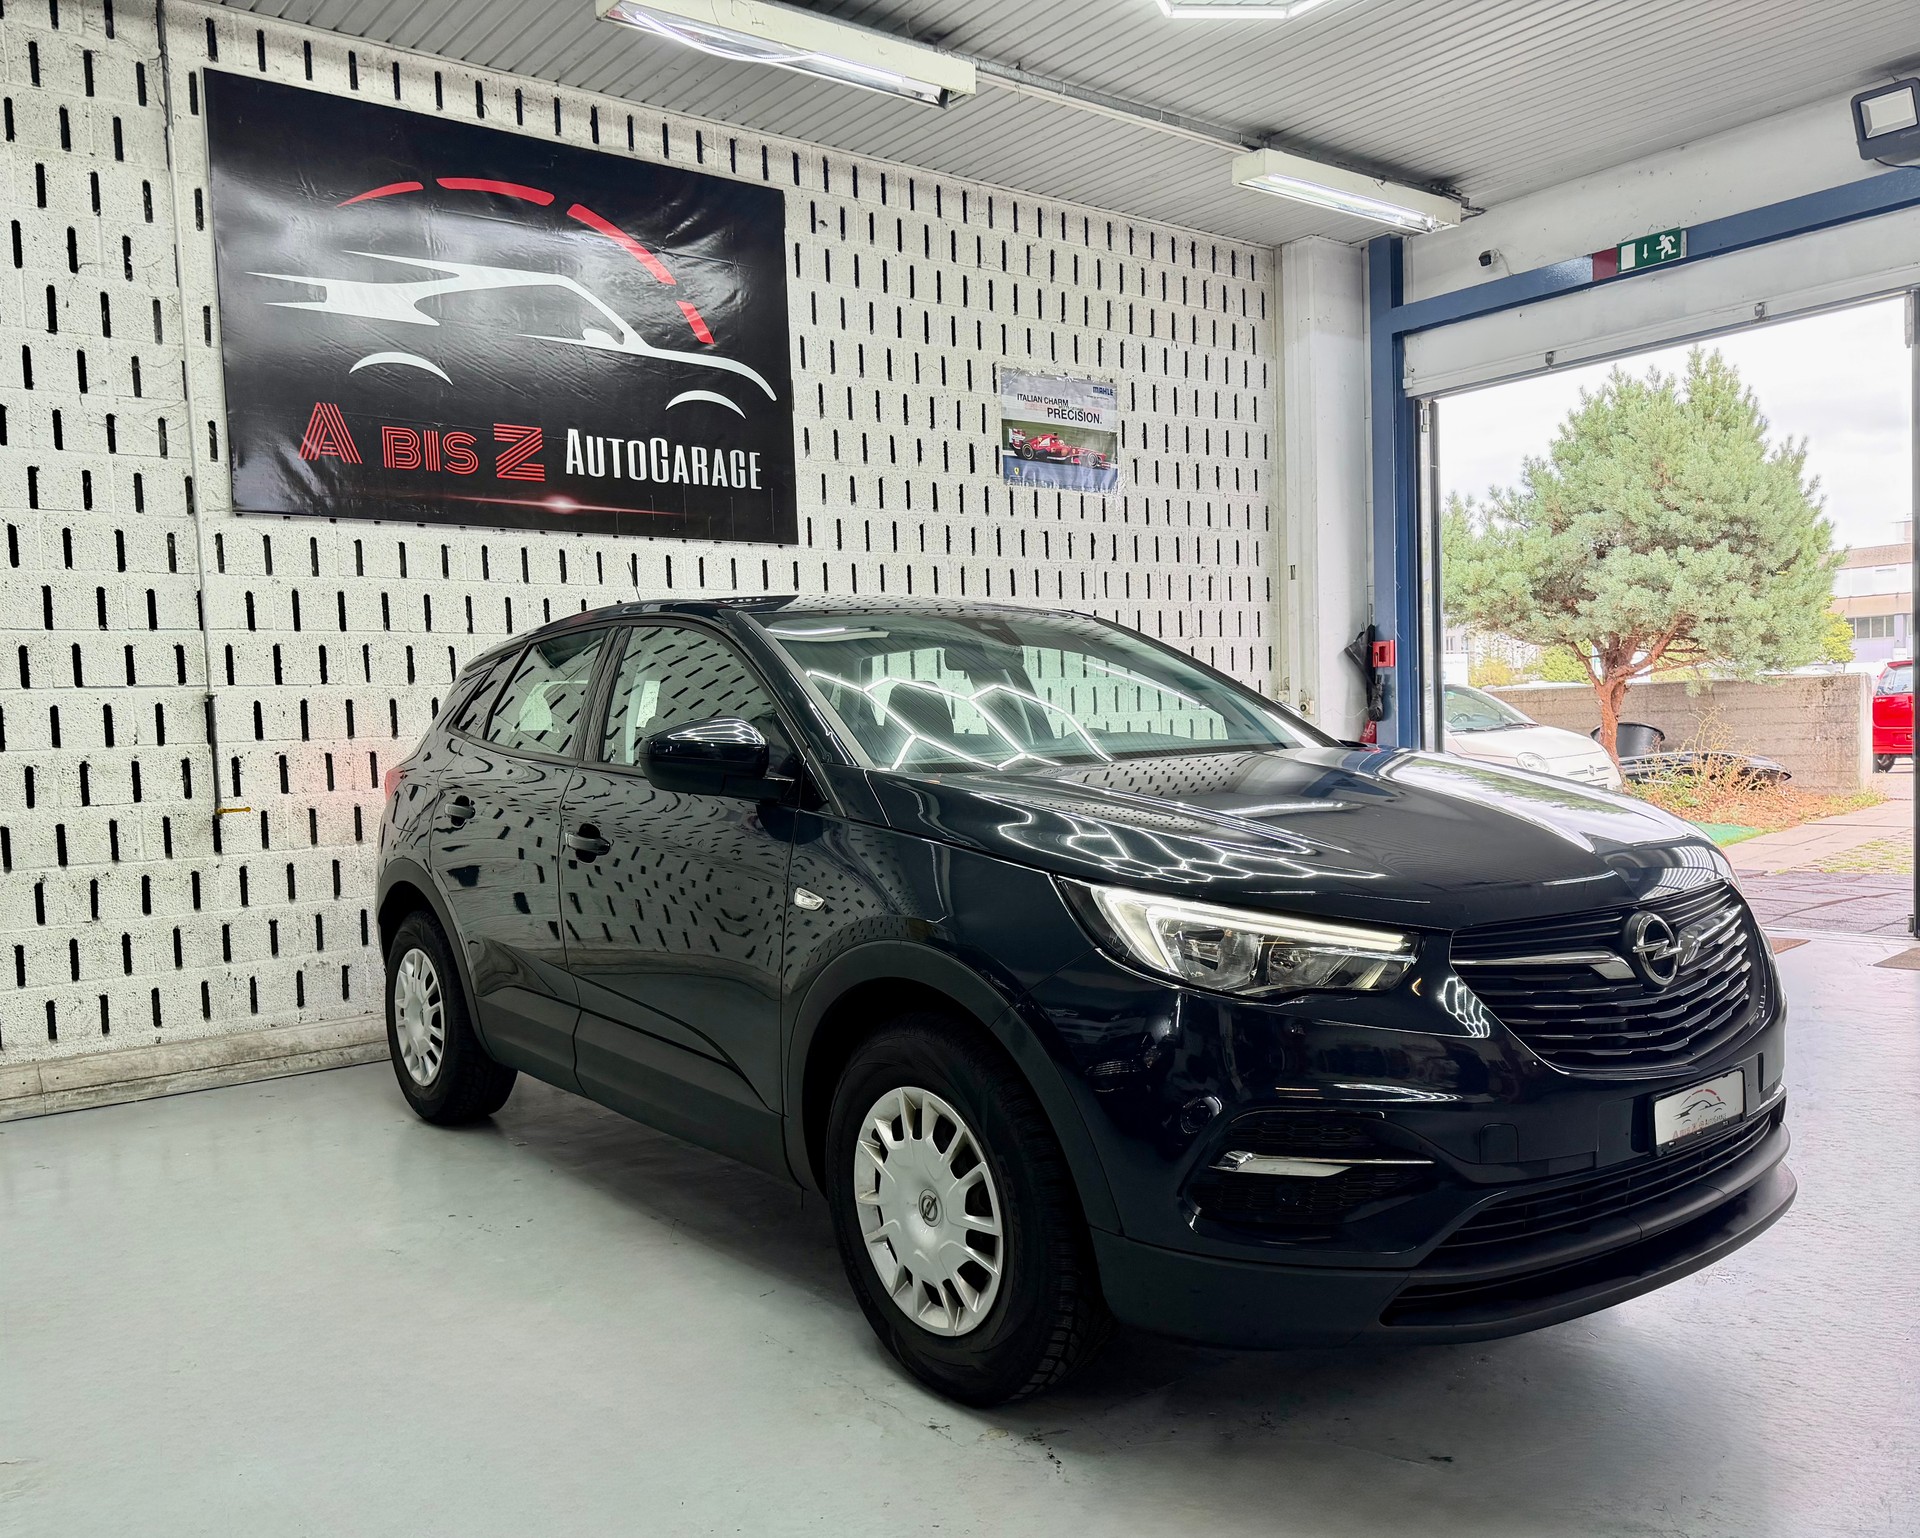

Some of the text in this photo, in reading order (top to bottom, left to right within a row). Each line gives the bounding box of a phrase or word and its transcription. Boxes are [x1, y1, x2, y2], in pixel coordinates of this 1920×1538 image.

[1017, 393, 1069, 407] ITALIAN CHARM
[1047, 407, 1102, 424] PRECISION.
[299, 402, 362, 464] A
[380, 424, 480, 476] BIS
[493, 422, 546, 482] Z
